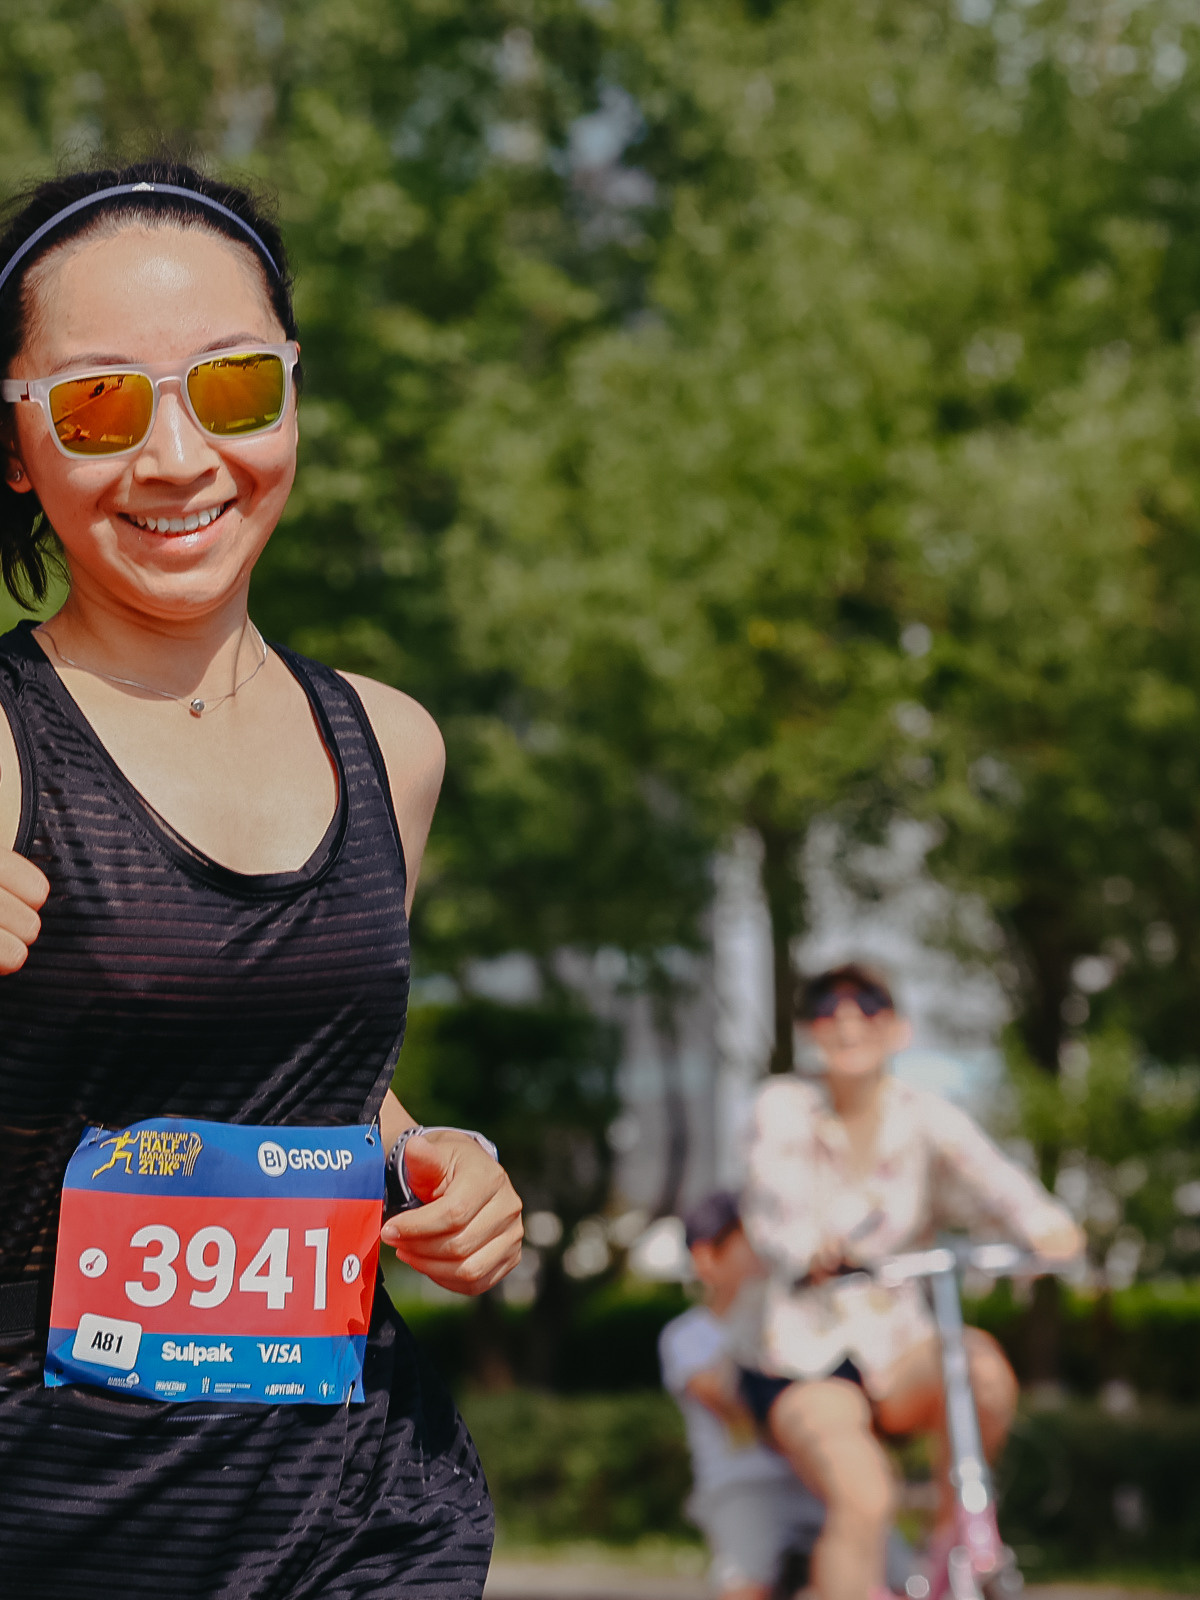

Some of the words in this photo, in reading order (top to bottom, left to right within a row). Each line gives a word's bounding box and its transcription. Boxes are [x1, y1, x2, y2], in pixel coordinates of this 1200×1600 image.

[139, 1136, 180, 1153] HALF
[139, 1151, 188, 1163] MARATHON
[288, 1148, 353, 1171] GROUP
[125, 1224, 330, 1310] 3941
[91, 1331, 124, 1354] A81
[161, 1341, 233, 1366] Sulpak
[256, 1343, 302, 1364] VISA
